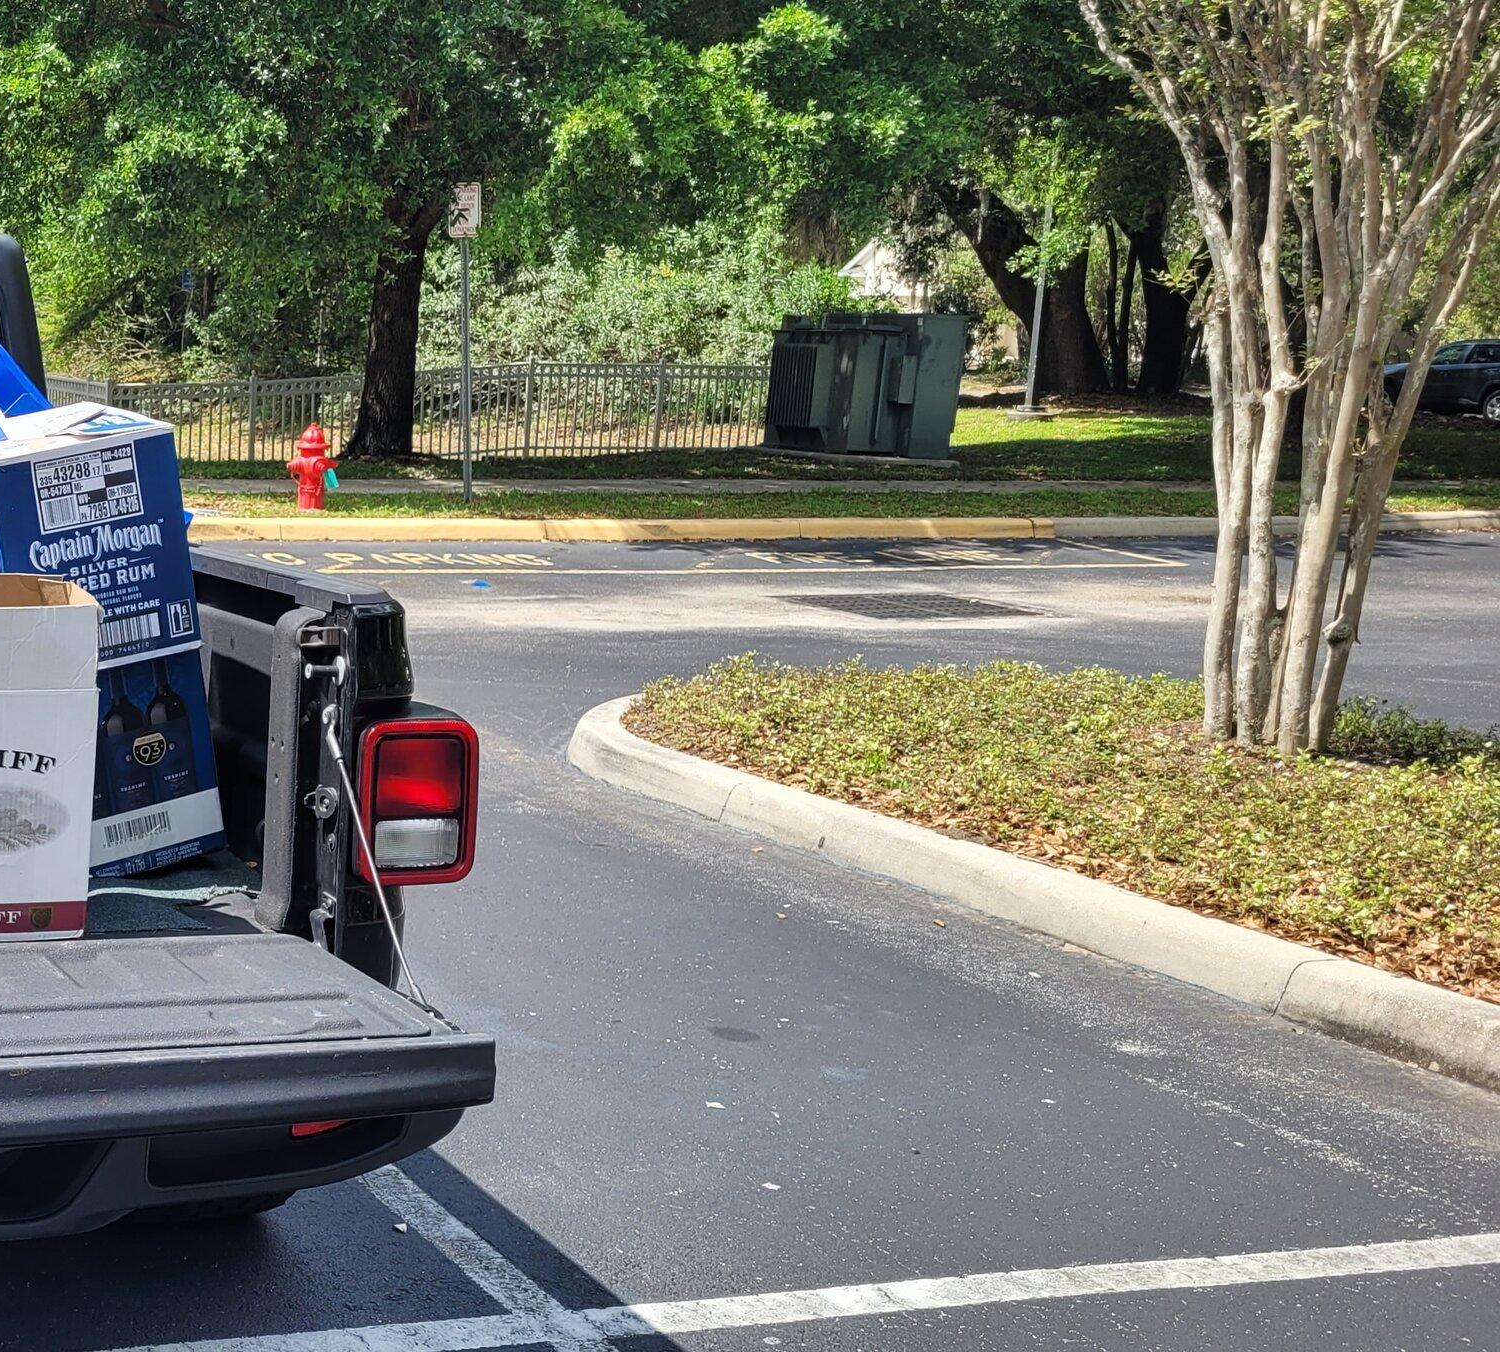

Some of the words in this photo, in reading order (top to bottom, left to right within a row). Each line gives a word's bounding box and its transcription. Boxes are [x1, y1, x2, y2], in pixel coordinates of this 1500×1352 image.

[39, 475, 53, 486] 335
[53, 461, 92, 482] 43298
[92, 465, 100, 477] 17
[29, 531, 95, 572] Captain
[91, 523, 163, 562] Morgan
[69, 556, 129, 577] SILVER
[246, 552, 306, 566] O
[323, 552, 554, 566] PARKING
[71, 572, 112, 591] CED
[116, 562, 156, 586] RUM
[113, 603, 137, 616] WITH
[137, 599, 161, 611] CARE
[182, 605, 187, 615] 6
[140, 742, 161, 761] 93
